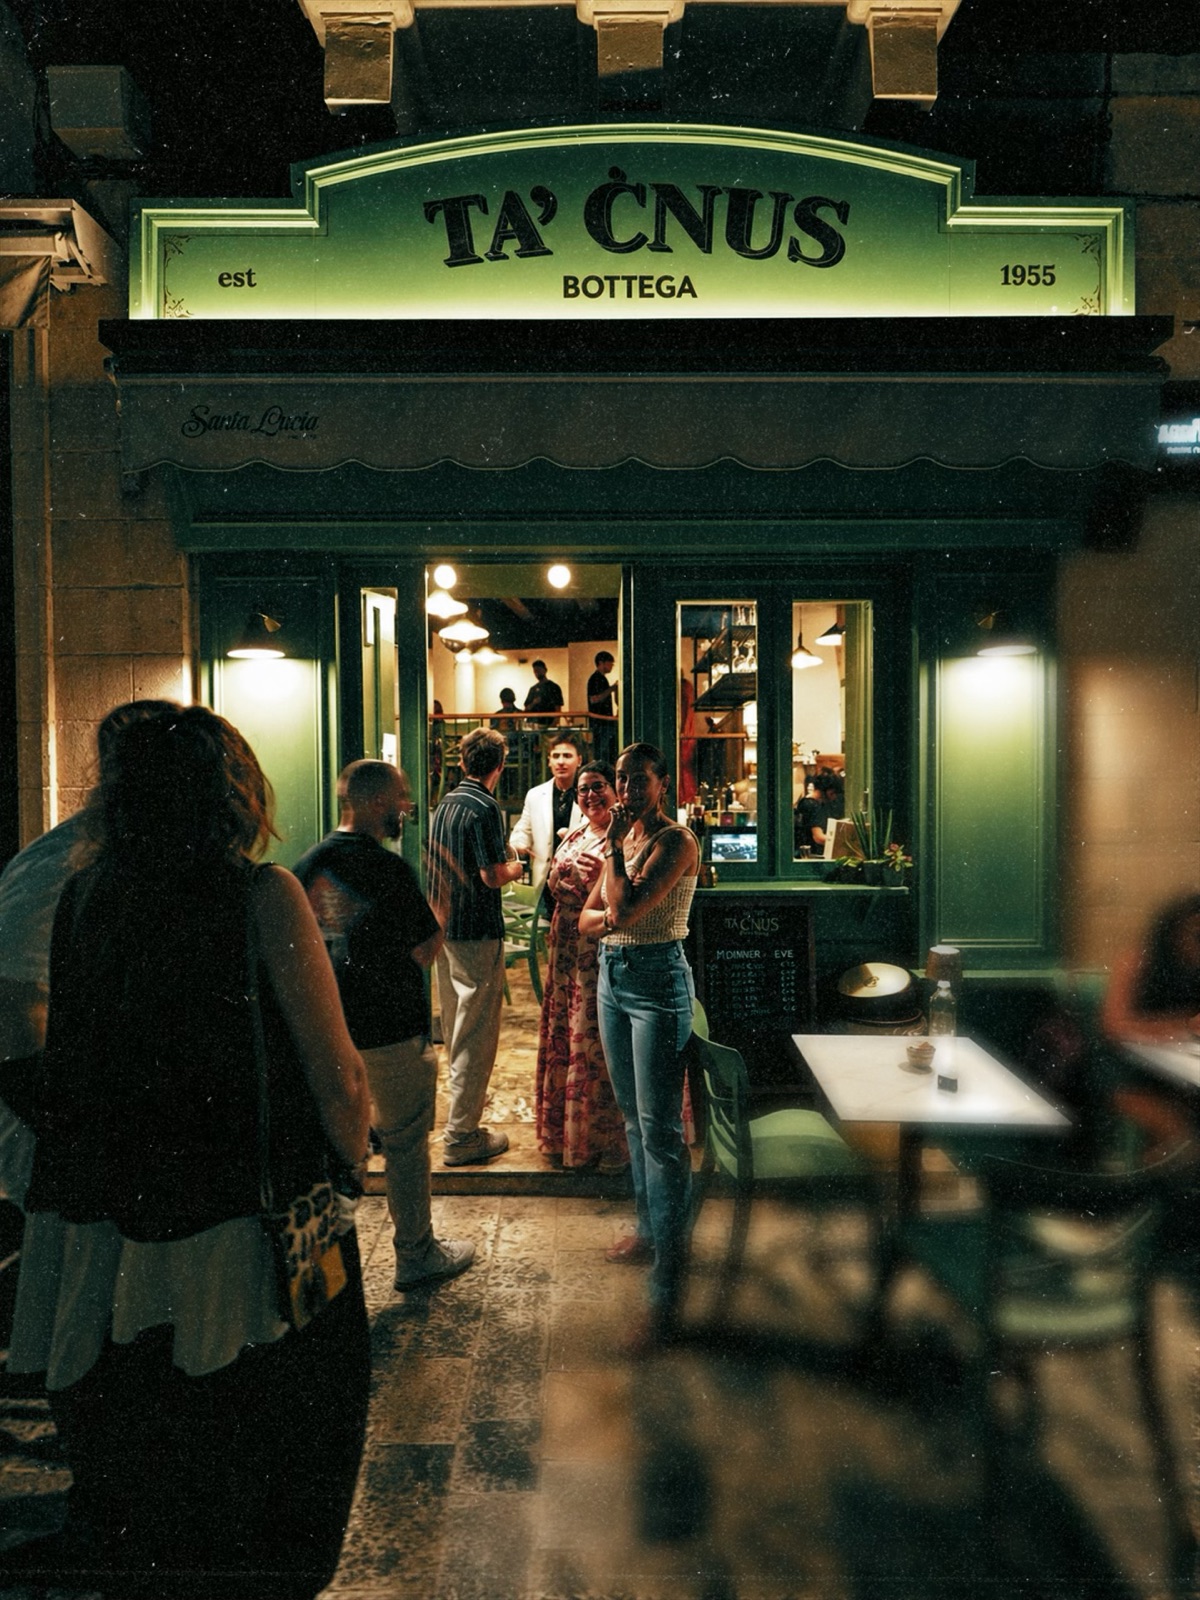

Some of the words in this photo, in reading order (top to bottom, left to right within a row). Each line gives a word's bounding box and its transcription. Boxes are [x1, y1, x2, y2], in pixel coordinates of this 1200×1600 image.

[583, 166, 850, 268] ĊNUS
[218, 268, 257, 288] est
[1000, 264, 1056, 286] 1955
[563, 275, 697, 299] BOTTEGA
[181, 405, 250, 438] Santa
[250, 405, 319, 436] Lucia
[774, 949, 793, 959] EVE
